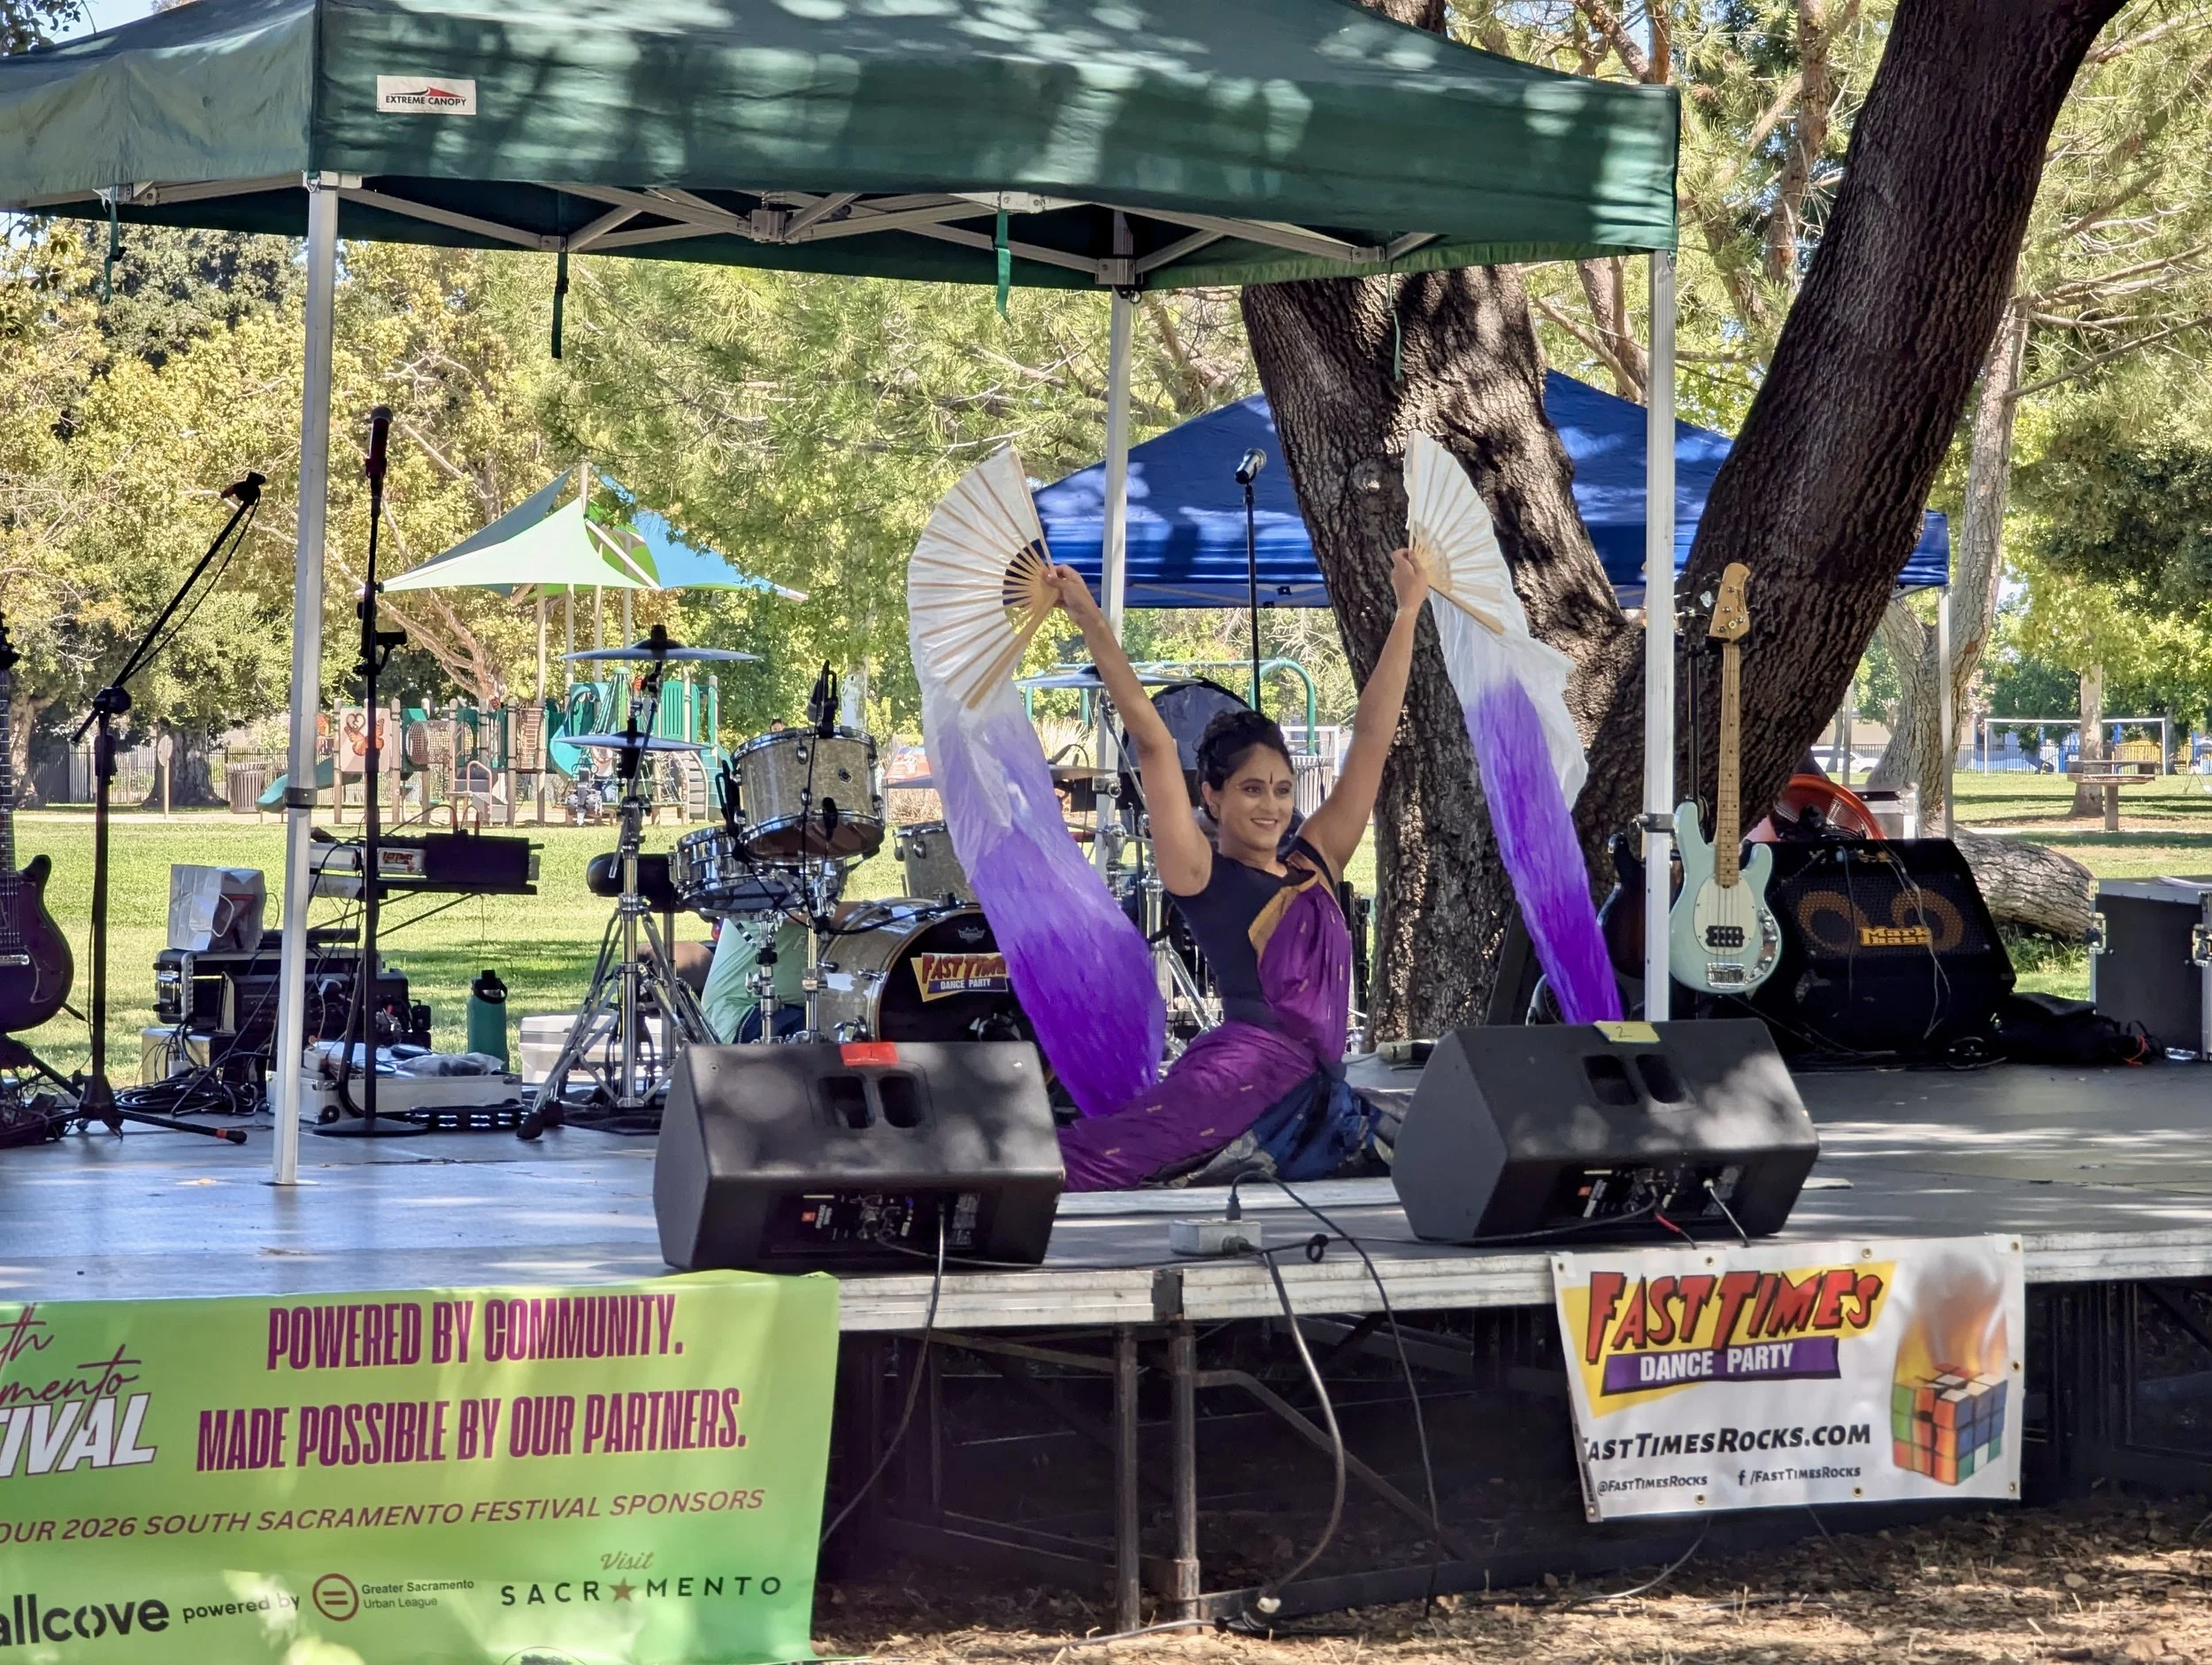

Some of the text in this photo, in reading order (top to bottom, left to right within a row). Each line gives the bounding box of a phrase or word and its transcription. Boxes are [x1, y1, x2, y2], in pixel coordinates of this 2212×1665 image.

[385, 95, 467, 106] EXTREME CANOPY
[922, 955, 964, 984] FAST
[941, 978, 991, 990] DANCE PARTY
[1615, 1025, 1633, 1038] 2
[267, 1293, 683, 1370] POWERED BY COMMUNITY.
[1586, 1269, 1885, 1365] FAST TIMES
[1640, 1343, 1794, 1382] DANCE PARTY
[0, 1392, 157, 1478] IVAL
[196, 1387, 747, 1472] MADE POSSIBLE BY OUR PARTNERS.
[62, 1516, 136, 1541] 2026
[143, 1511, 250, 1535] SOUTH
[256, 1503, 463, 1531] SACRAMENTO
[470, 1496, 601, 1523] FESTIVAL
[608, 1489, 765, 1516] SPONSORS
[600, 1550, 655, 1571] Visit
[361, 1579, 474, 1595] Greater Sacramento
[364, 1596, 438, 1608] Urban League
[182, 1592, 300, 1623] powered by
